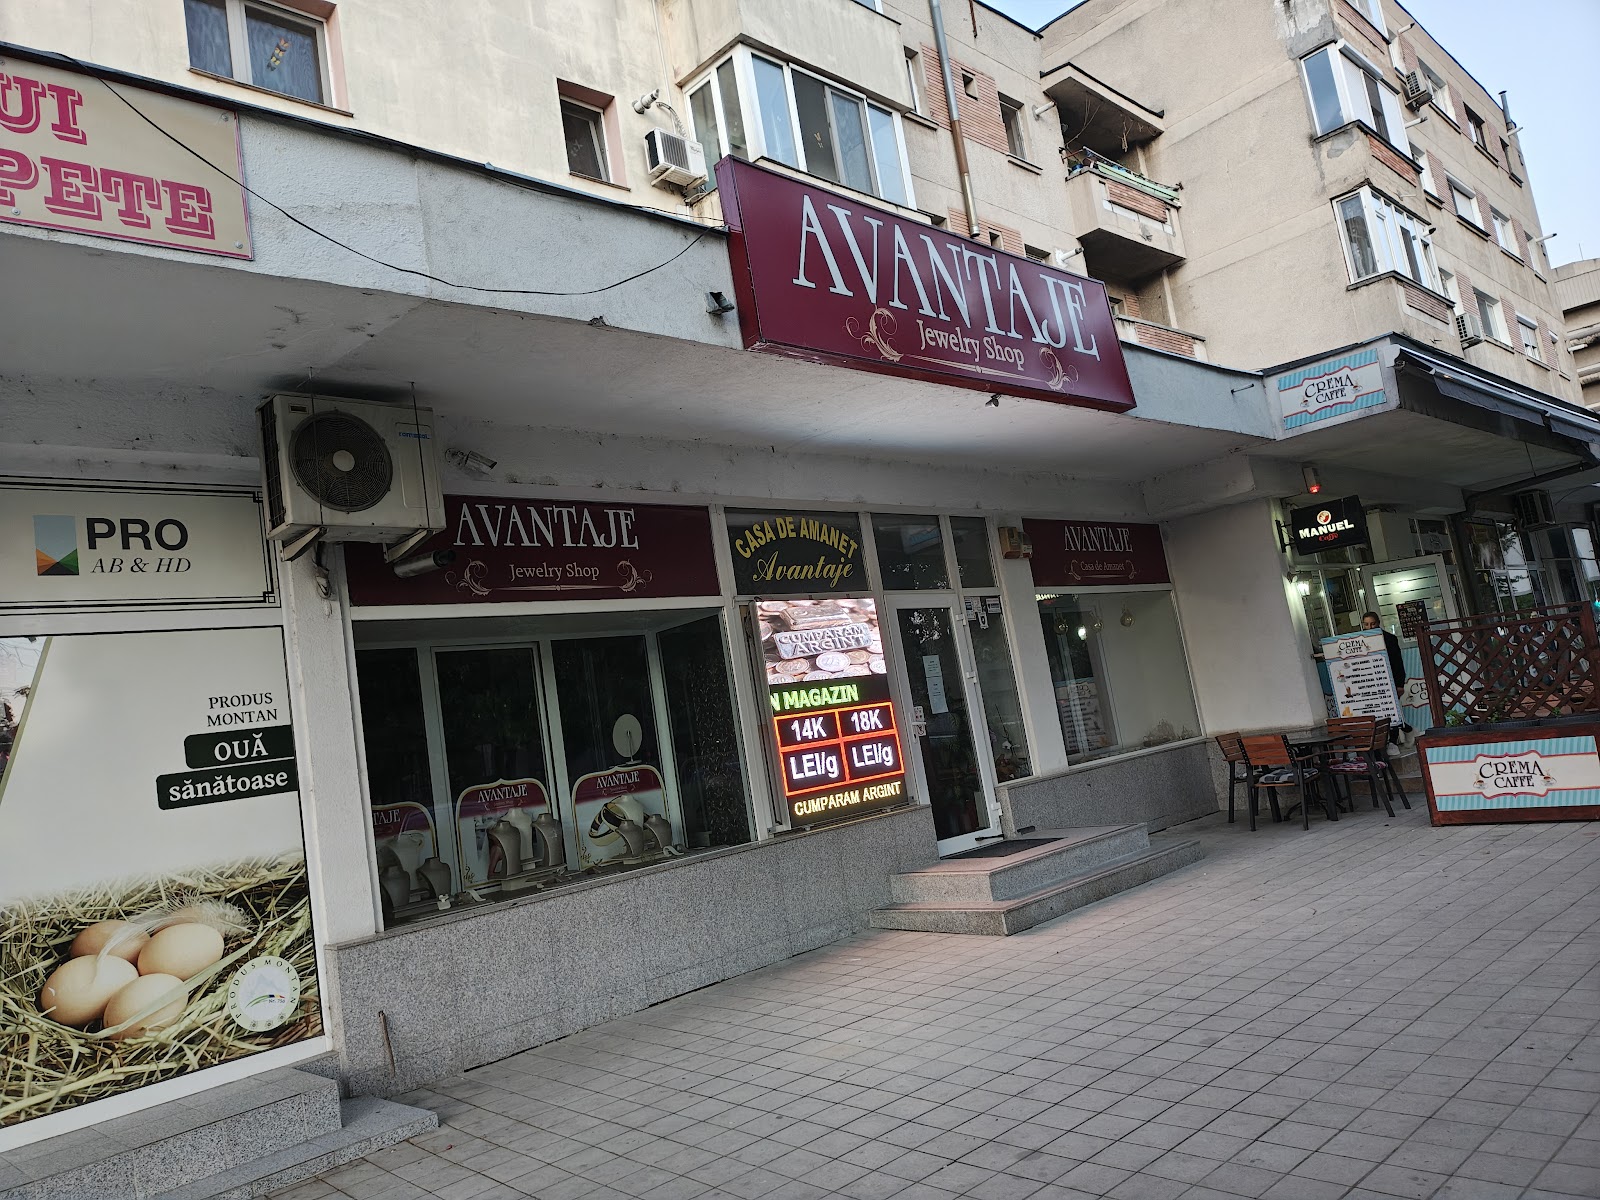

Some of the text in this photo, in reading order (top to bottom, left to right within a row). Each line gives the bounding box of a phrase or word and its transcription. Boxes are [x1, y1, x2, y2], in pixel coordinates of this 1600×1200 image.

[0, 149, 215, 240] PETE
[792, 194, 1100, 361] AVANTAJE
[916, 319, 1025, 371] Jewelry Shop
[1305, 374, 1354, 398] CREMA
[1316, 388, 1347, 404] CAFFE
[86, 517, 188, 551] PRO
[453, 502, 639, 550] AVANTAJE
[735, 516, 859, 559] CASA DE AMANET
[1298, 519, 1355, 539] MANUEL
[1064, 525, 1133, 553] AVANTAJE
[90, 557, 191, 573] AB & HD
[509, 562, 600, 581] Jewelry Shop
[752, 550, 853, 589] Avantaje
[1095, 560, 1102, 571] de
[780, 625, 865, 644] CUMPARAM
[793, 635, 866, 655] ARGINT
[1338, 639, 1368, 651] CREMA
[208, 692, 273, 709] PRODUS
[783, 684, 859, 710] MAGAZIN
[207, 708, 278, 727] MONTAN
[791, 709, 883, 741] 14K 18K
[214, 732, 268, 762] OUĂ
[789, 742, 894, 780] LEI/g LEI/g
[1479, 760, 1546, 779] CREMA
[168, 771, 289, 802] sănătoase
[596, 771, 640, 788] AVANTAJE
[1494, 775, 1535, 788] CAFFE
[477, 784, 528, 803] AVANTAJE
[794, 781, 901, 816] CUMPARAM ARGINT
